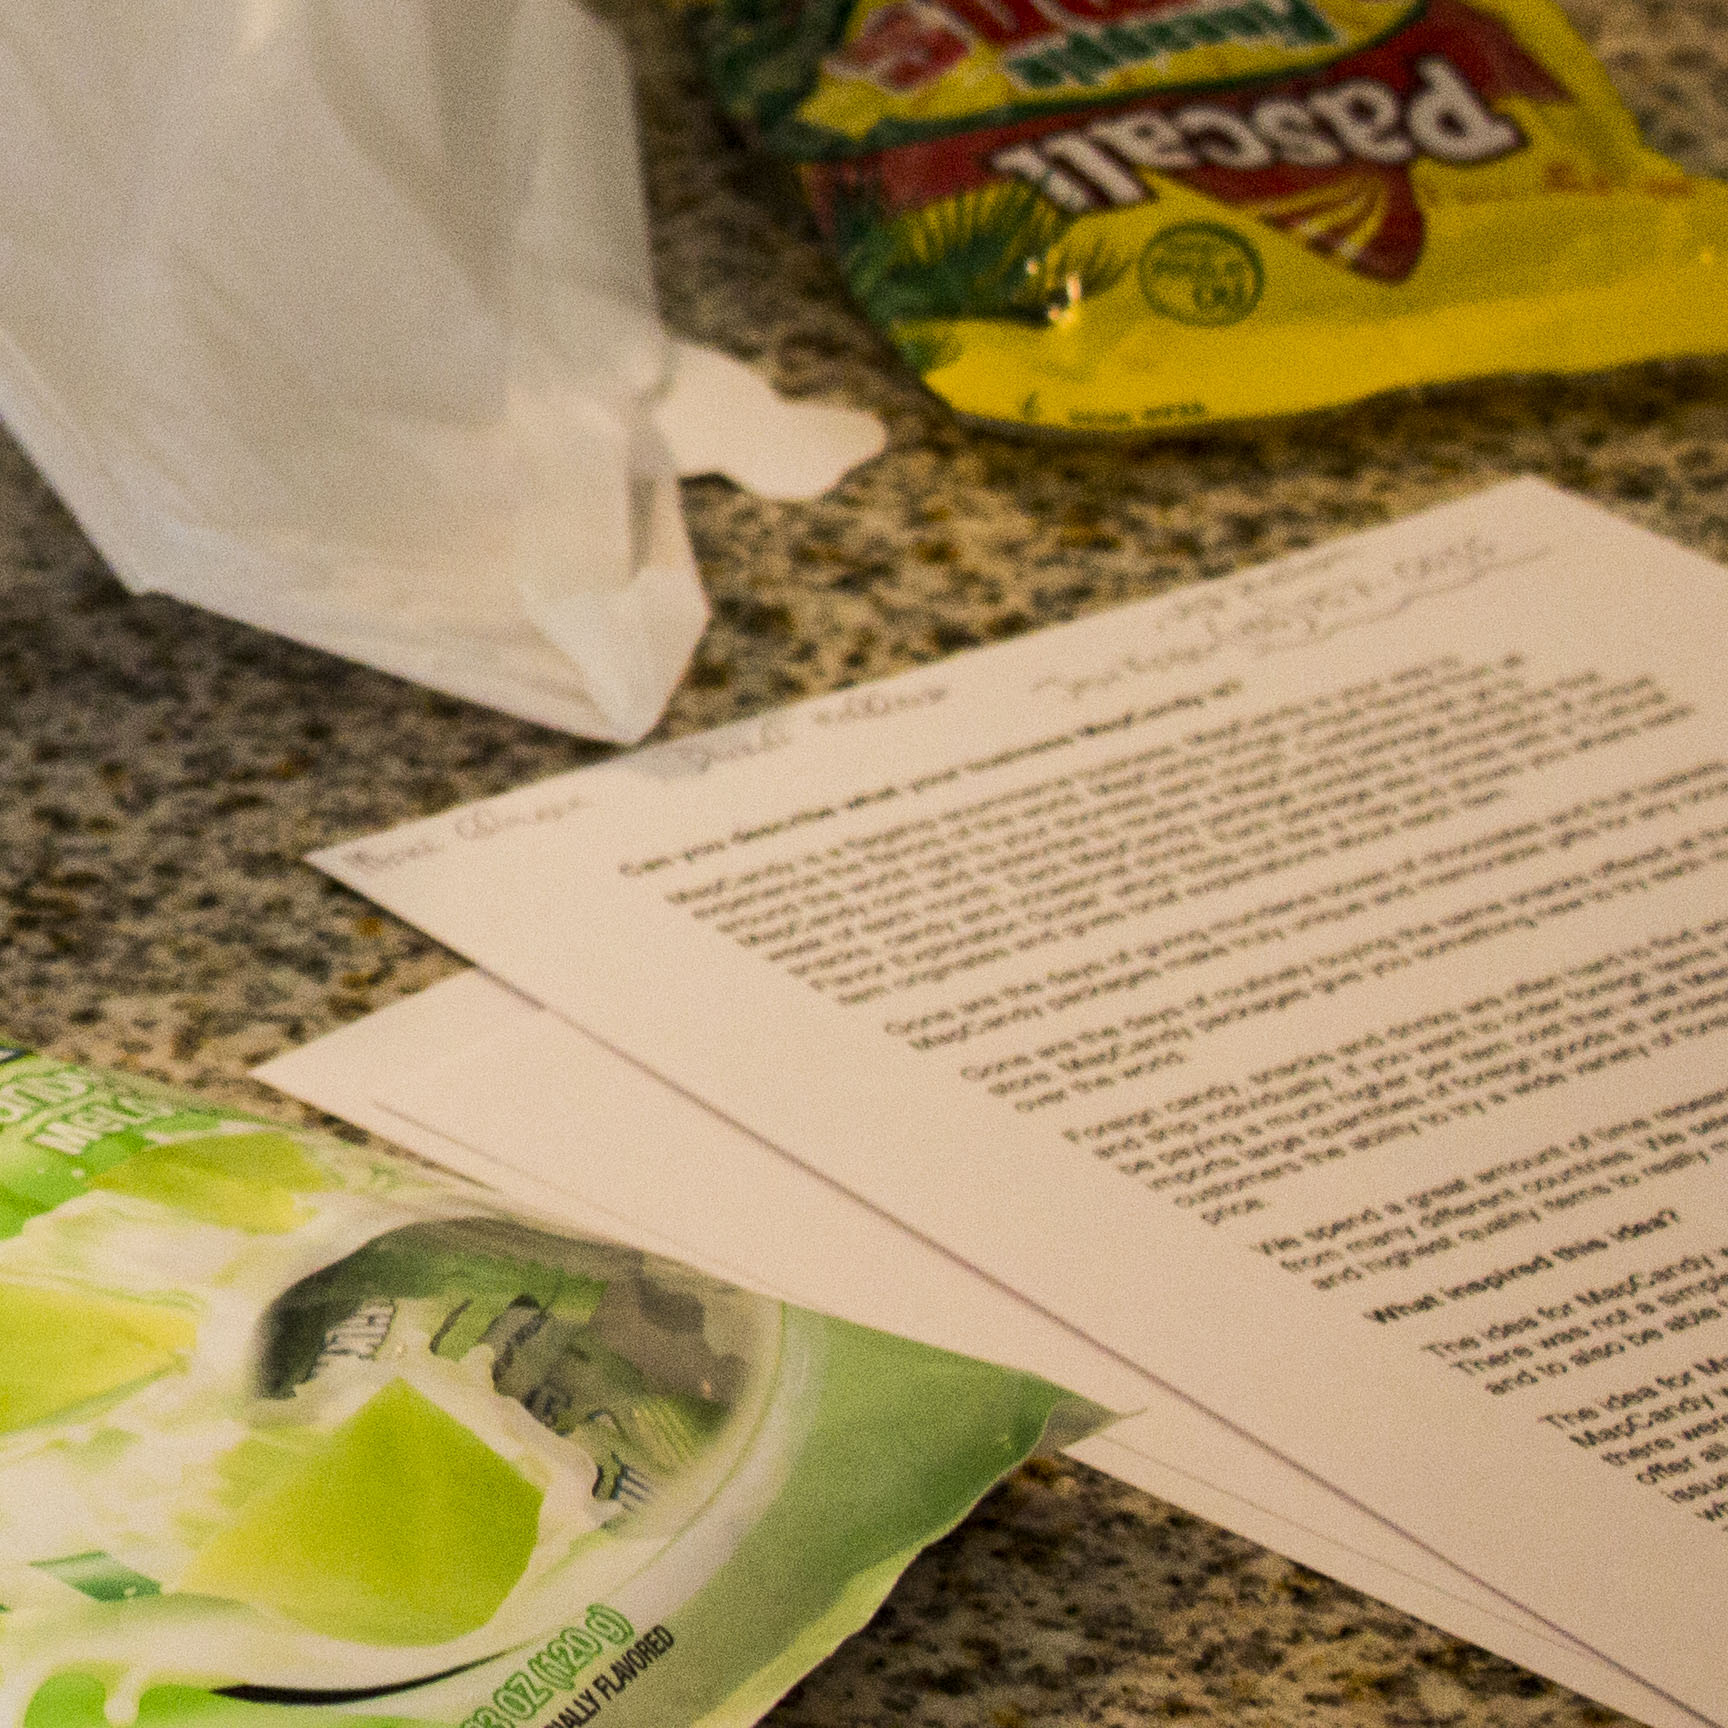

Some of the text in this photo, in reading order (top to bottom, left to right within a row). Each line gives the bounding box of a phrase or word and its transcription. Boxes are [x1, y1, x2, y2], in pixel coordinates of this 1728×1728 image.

[988, 54, 1530, 214] Pascall
[1070, 1073, 1117, 1094] the
[1337, 1032, 1386, 1058] and
[1304, 1207, 1384, 1244] spend
[1405, 1177, 1470, 1210] great
[1473, 1144, 1566, 1186] amount
[1566, 1133, 1593, 1154] of
[1277, 1246, 1344, 1274] from
[1344, 1223, 1418, 1255] many
[1417, 1185, 1519, 1231] different
[1310, 1267, 1364, 1292] and
[1358, 1234, 1456, 1273] highest
[1457, 1207, 1543, 1244] quality
[1362, 1206, 1682, 1326] What inspired this idea?
[1418, 1253, 1715, 1358] The idea for MapCandy
[1449, 1344, 1535, 1376] There
[1537, 1326, 1592, 1350] was
[1591, 1308, 1633, 1330] not
[1635, 1301, 1658, 1317] a
[1484, 1305, 1722, 1396] and to also be able
[1538, 1406, 1600, 1430] The
[1599, 1385, 1661, 1412] idea
[1655, 1371, 1696, 1391] for
[1569, 1394, 1716, 1449] MapCandy
[1600, 1436, 1676, 1467] there
[1634, 1457, 1695, 1486] offer
[493, 1671, 554, 1721] OZ
[592, 1623, 676, 1703] FLAVORED
